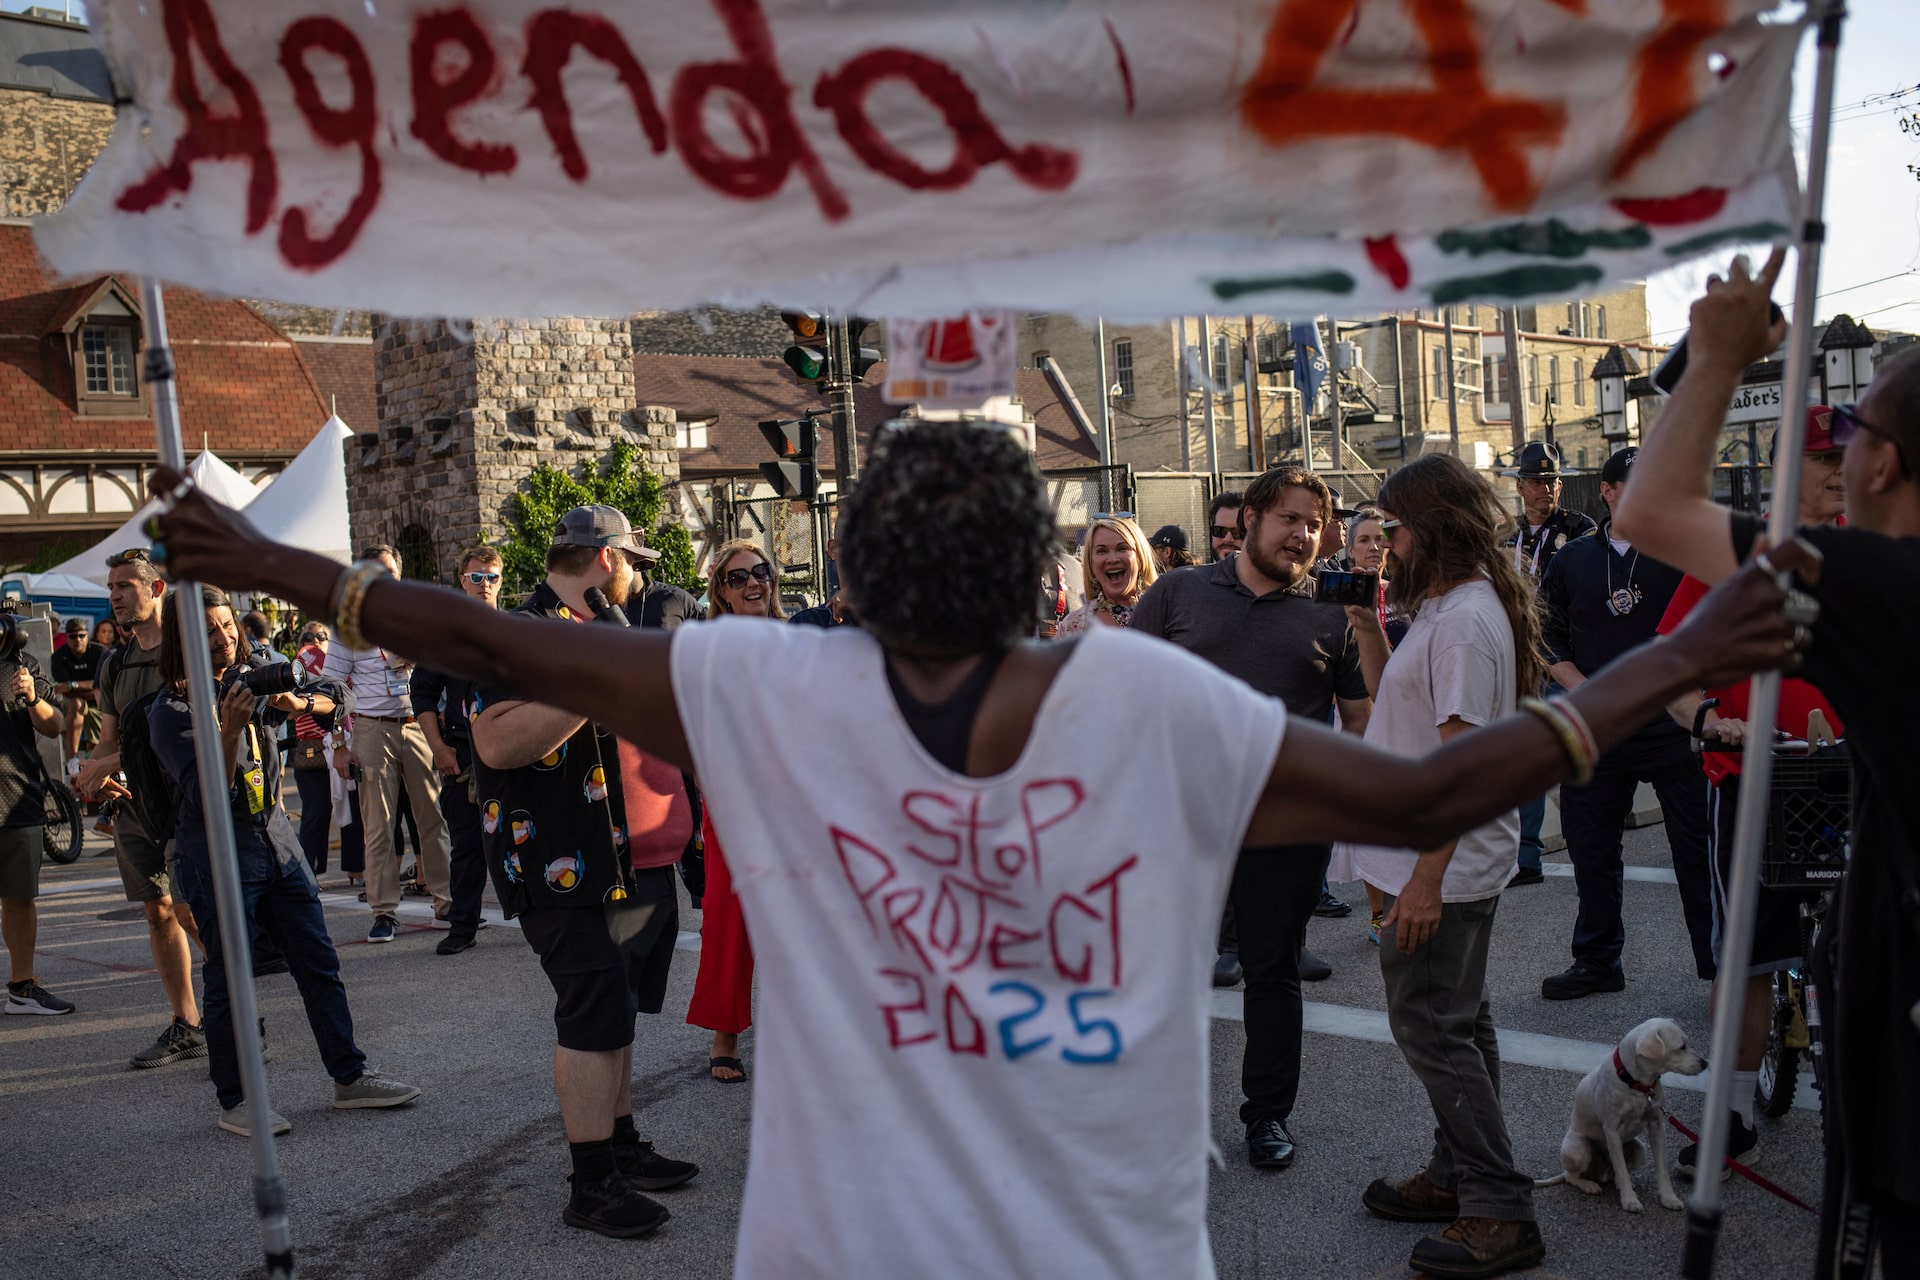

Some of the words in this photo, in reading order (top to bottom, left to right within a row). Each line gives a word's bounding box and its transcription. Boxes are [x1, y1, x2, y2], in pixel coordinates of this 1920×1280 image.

[115, 0, 1079, 271] Agenda
[1730, 387, 1780, 410] ader's
[878, 967, 1124, 1064] 2025
